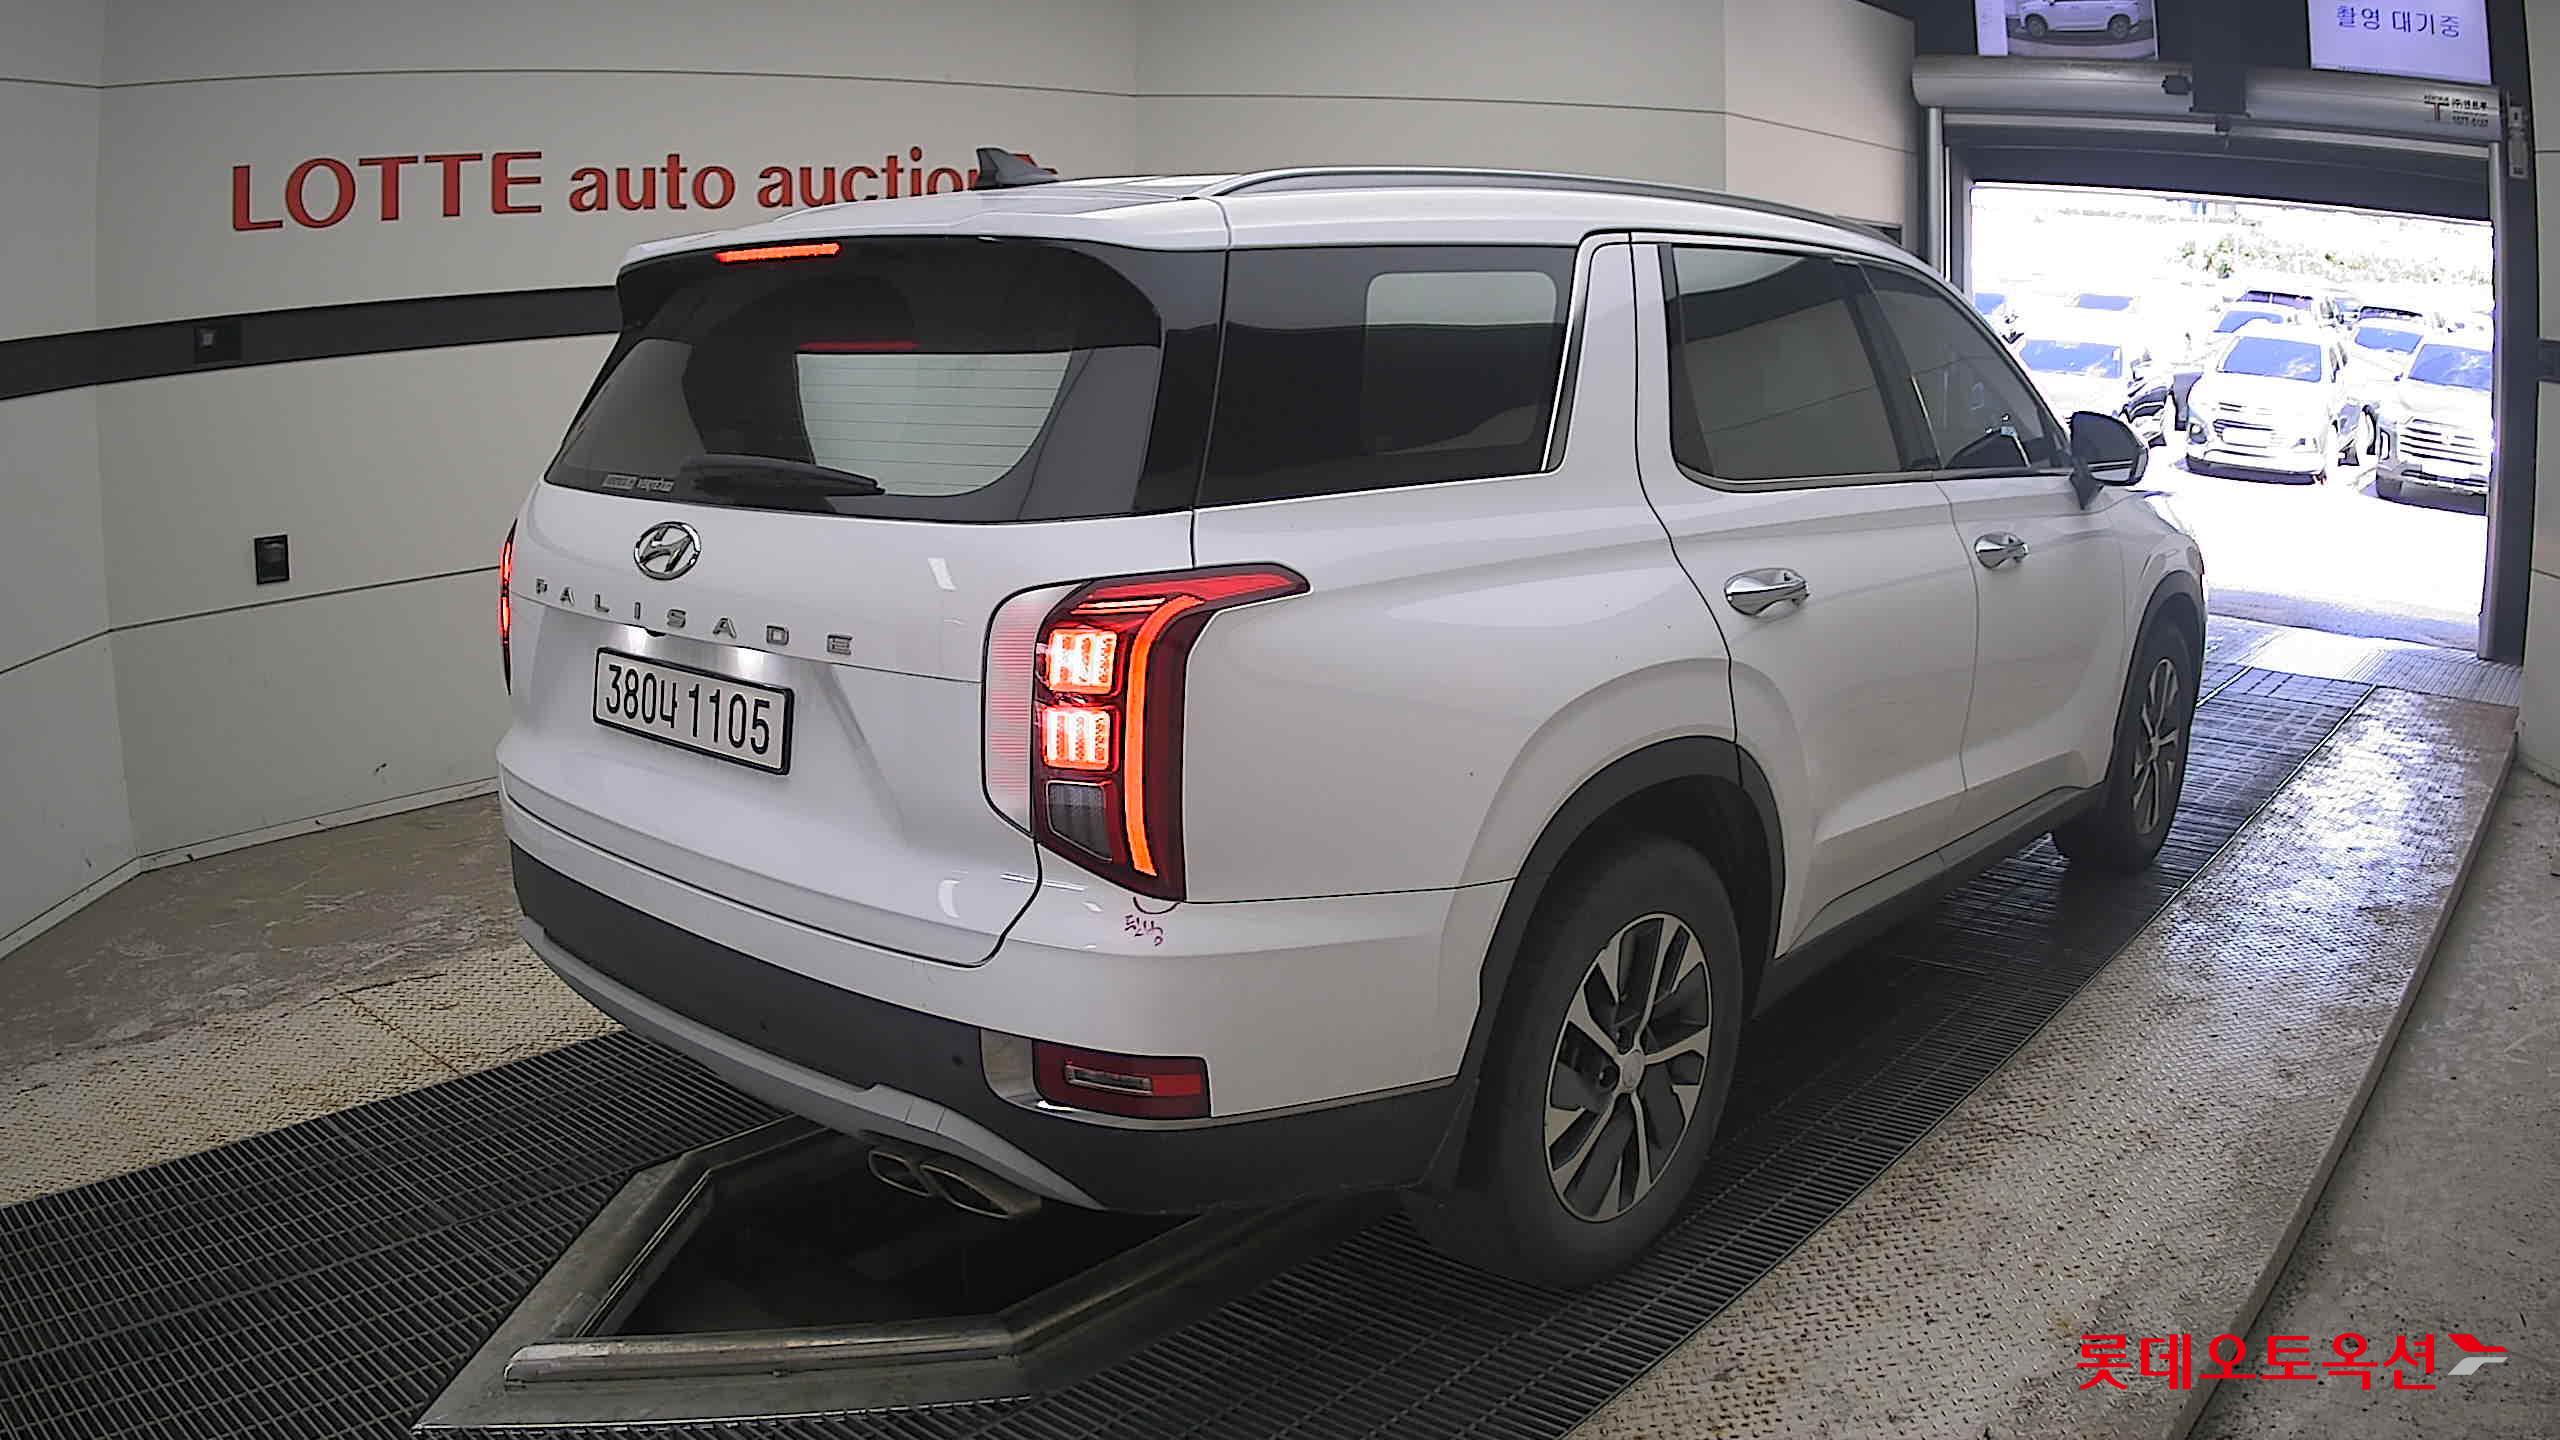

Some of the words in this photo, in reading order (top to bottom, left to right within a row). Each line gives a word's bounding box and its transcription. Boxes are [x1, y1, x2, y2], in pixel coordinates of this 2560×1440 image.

[2336, 5, 2381, 31] 촬영
[2391, 10, 2461, 39] 대기중
[231, 150, 543, 232] LOTTE
[568, 152, 737, 212] auto
[757, 146, 979, 208] auctio
[535, 578, 853, 657] PALISADE
[606, 663, 678, 729] 380나
[688, 683, 771, 755] 1105
